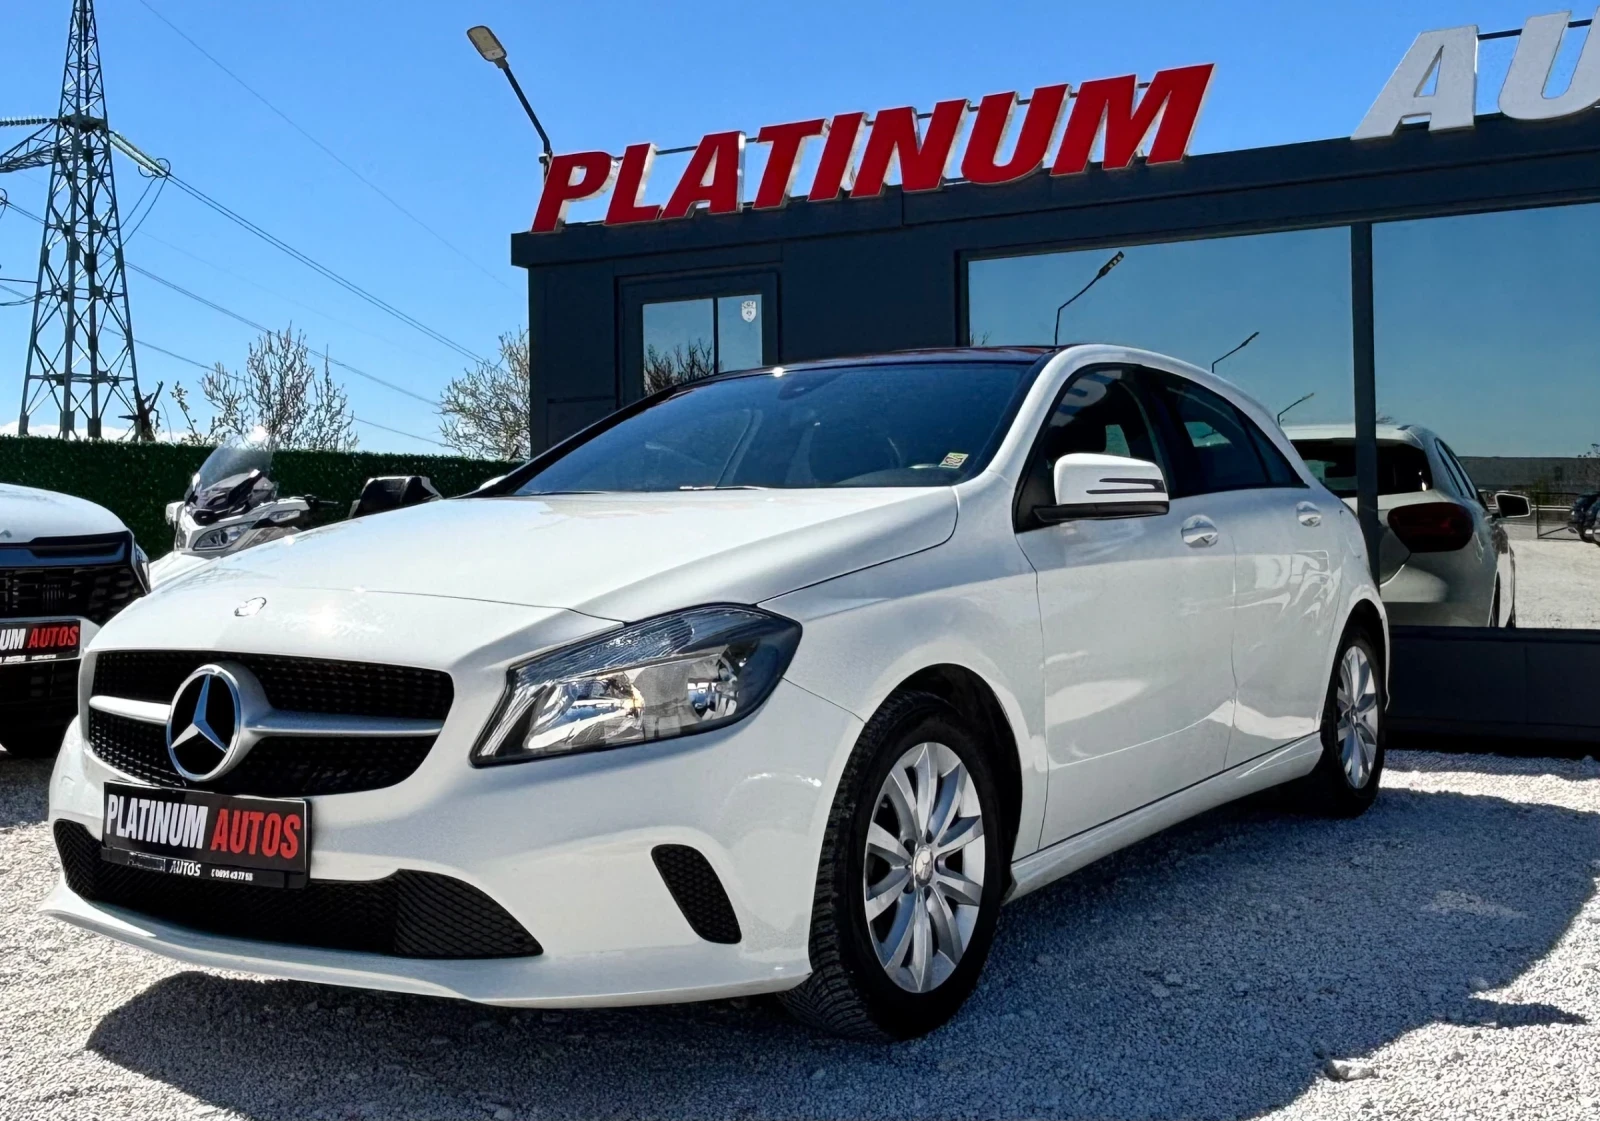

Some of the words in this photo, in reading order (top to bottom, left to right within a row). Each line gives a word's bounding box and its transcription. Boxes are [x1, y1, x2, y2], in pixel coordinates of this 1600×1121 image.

[529, 63, 1217, 233] PLATINUM
[1350, 6, 1600, 140] AU
[27, 626, 79, 649] AUTOS
[106, 794, 209, 850] PLATINUM
[210, 808, 301, 859] AUTOS
[169, 860, 202, 876] AUTOS
